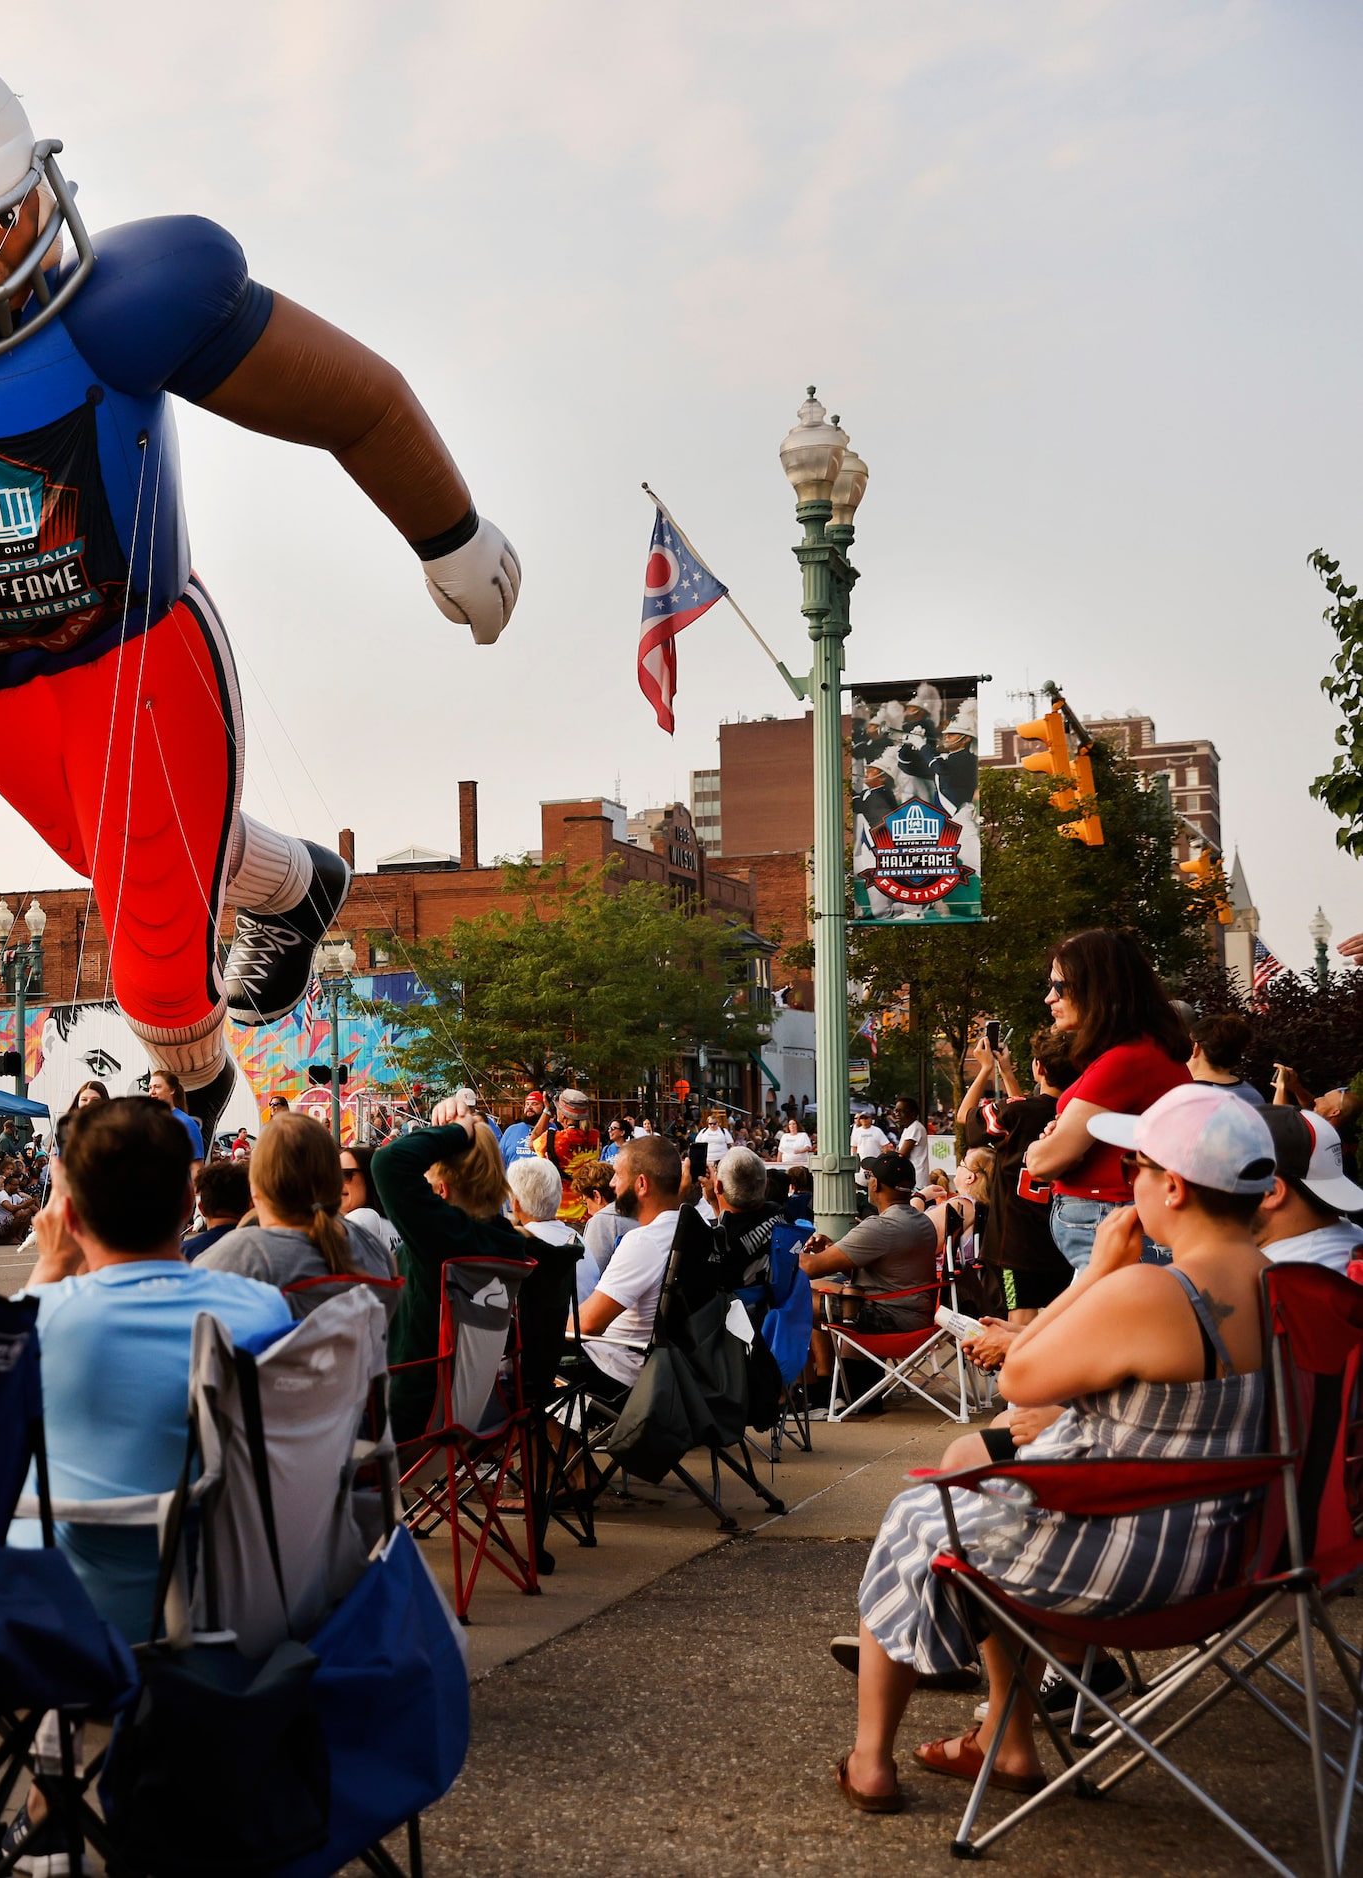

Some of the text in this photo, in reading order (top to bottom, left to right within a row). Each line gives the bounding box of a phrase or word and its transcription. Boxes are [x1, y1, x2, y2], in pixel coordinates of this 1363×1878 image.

[4, 542, 36, 555] OHIO
[10, 562, 82, 604] FAME
[669, 845, 698, 872] WILSON
[880, 855, 913, 868] HALL
[920, 854, 953, 867] FAME
[877, 868, 956, 876] ENSHRINEMENT
[879, 877, 956, 899] FESTIVAL
